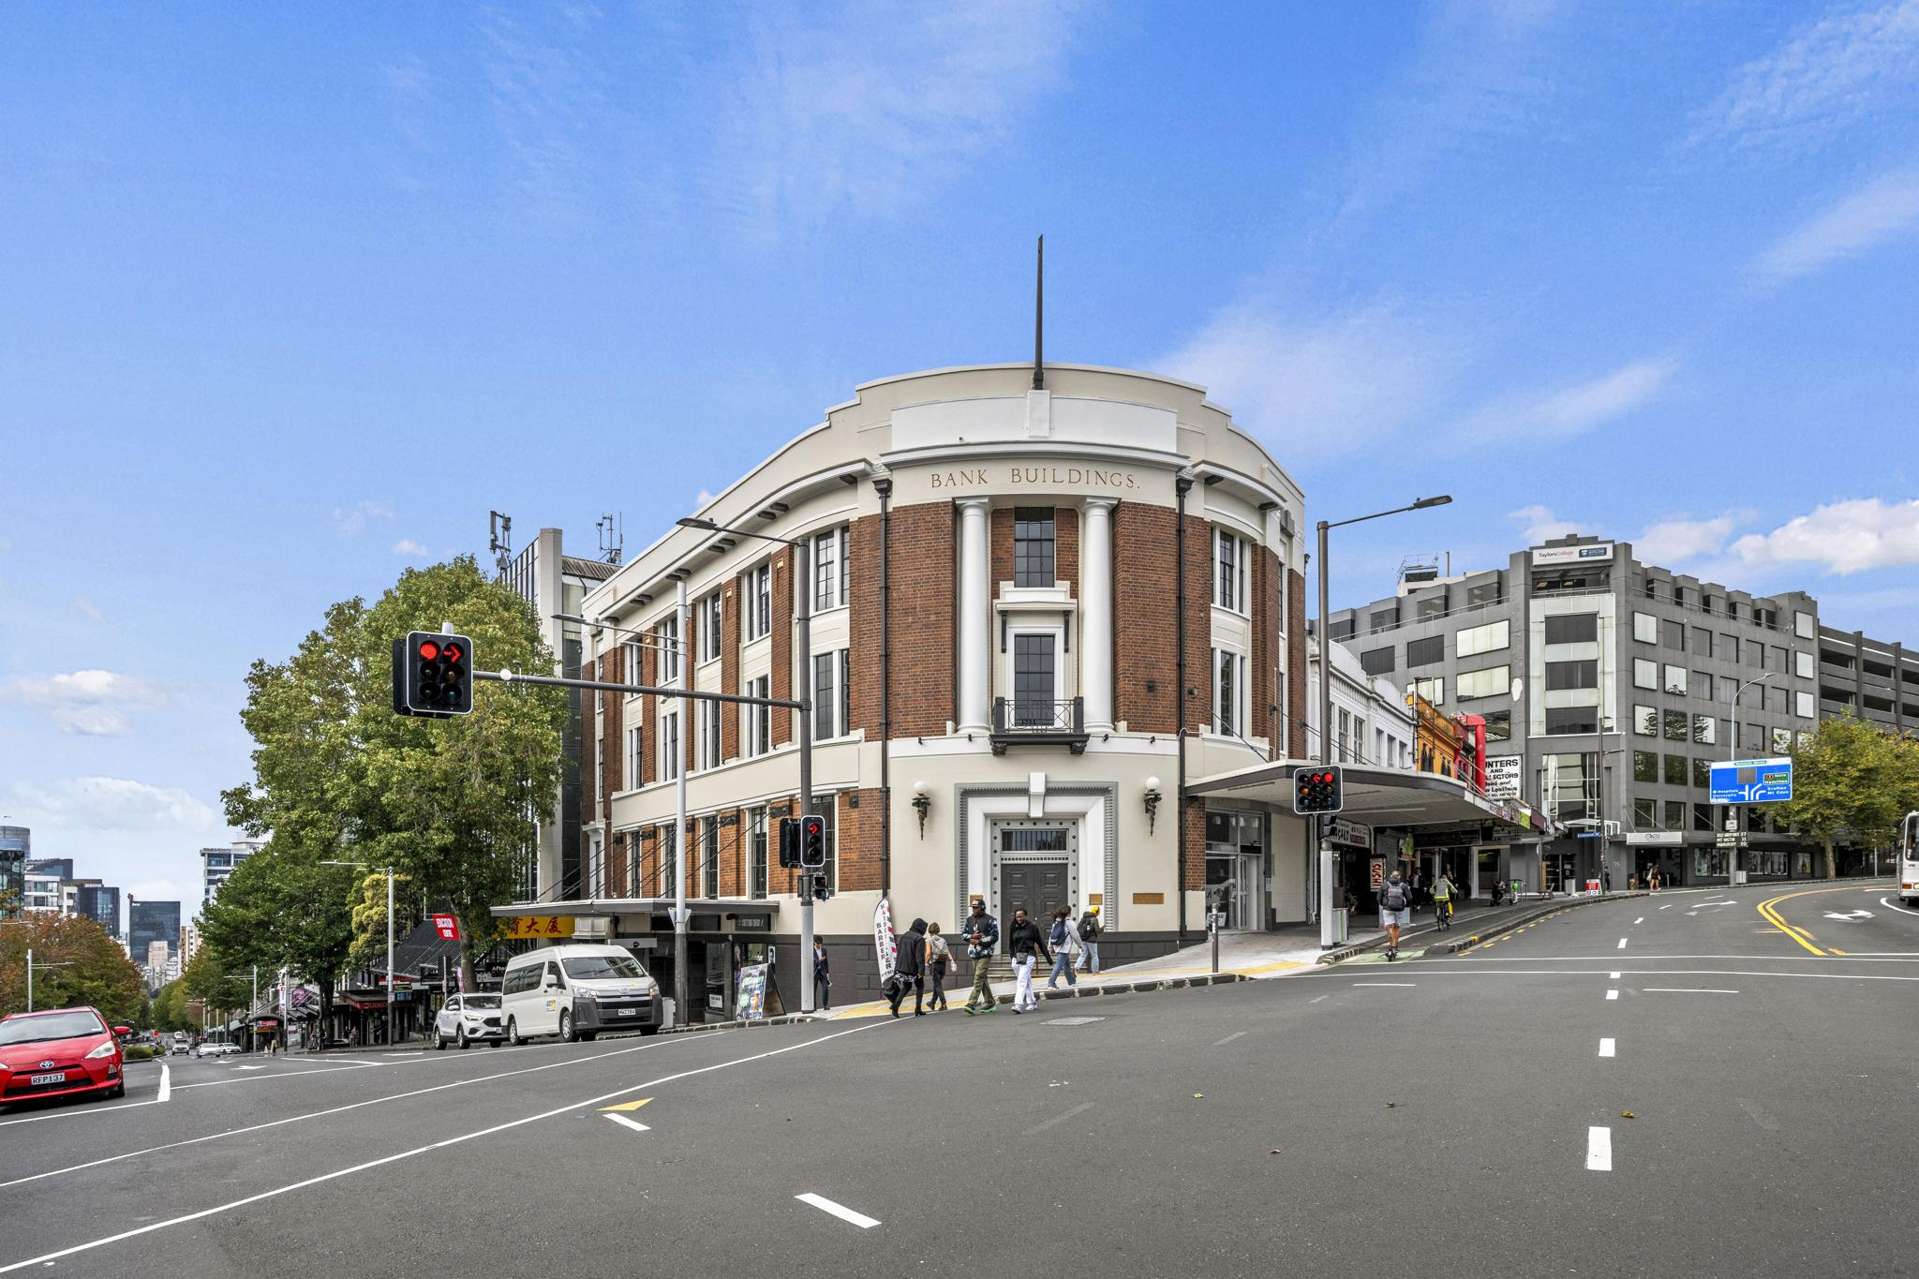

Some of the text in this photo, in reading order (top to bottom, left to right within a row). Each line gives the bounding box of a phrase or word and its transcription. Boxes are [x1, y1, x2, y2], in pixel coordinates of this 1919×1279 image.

[931, 467, 1140, 489] BANK BUILDINGS.
[1372, 863, 1382, 886] SUSHI
[876, 922, 886, 960] BARBER
